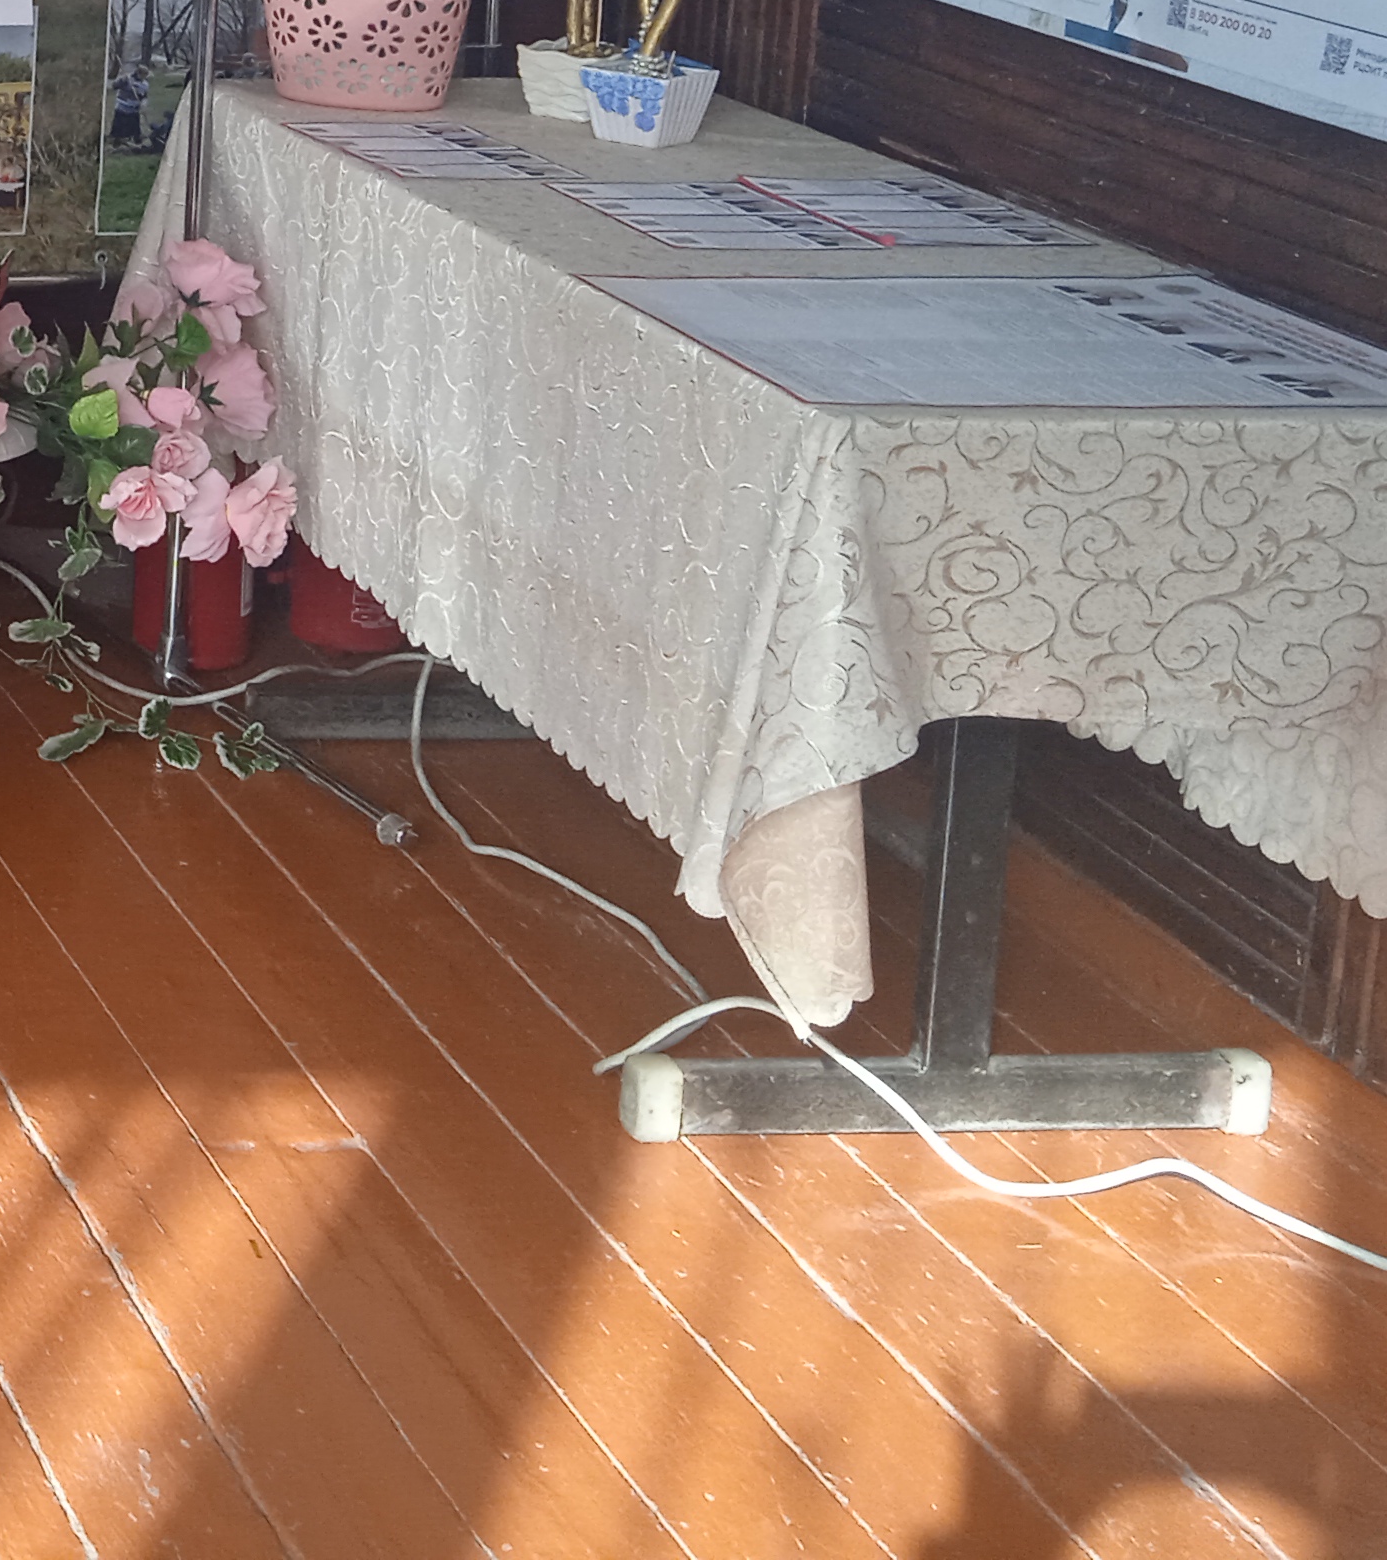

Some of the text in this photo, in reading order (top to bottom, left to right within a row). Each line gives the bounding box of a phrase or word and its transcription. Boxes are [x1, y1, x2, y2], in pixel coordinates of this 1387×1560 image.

[1197, 10, 1218, 25] 800
[1219, 16, 1240, 31] 200
[1242, 22, 1256, 35] 00
[1256, 27, 1272, 40] 20
